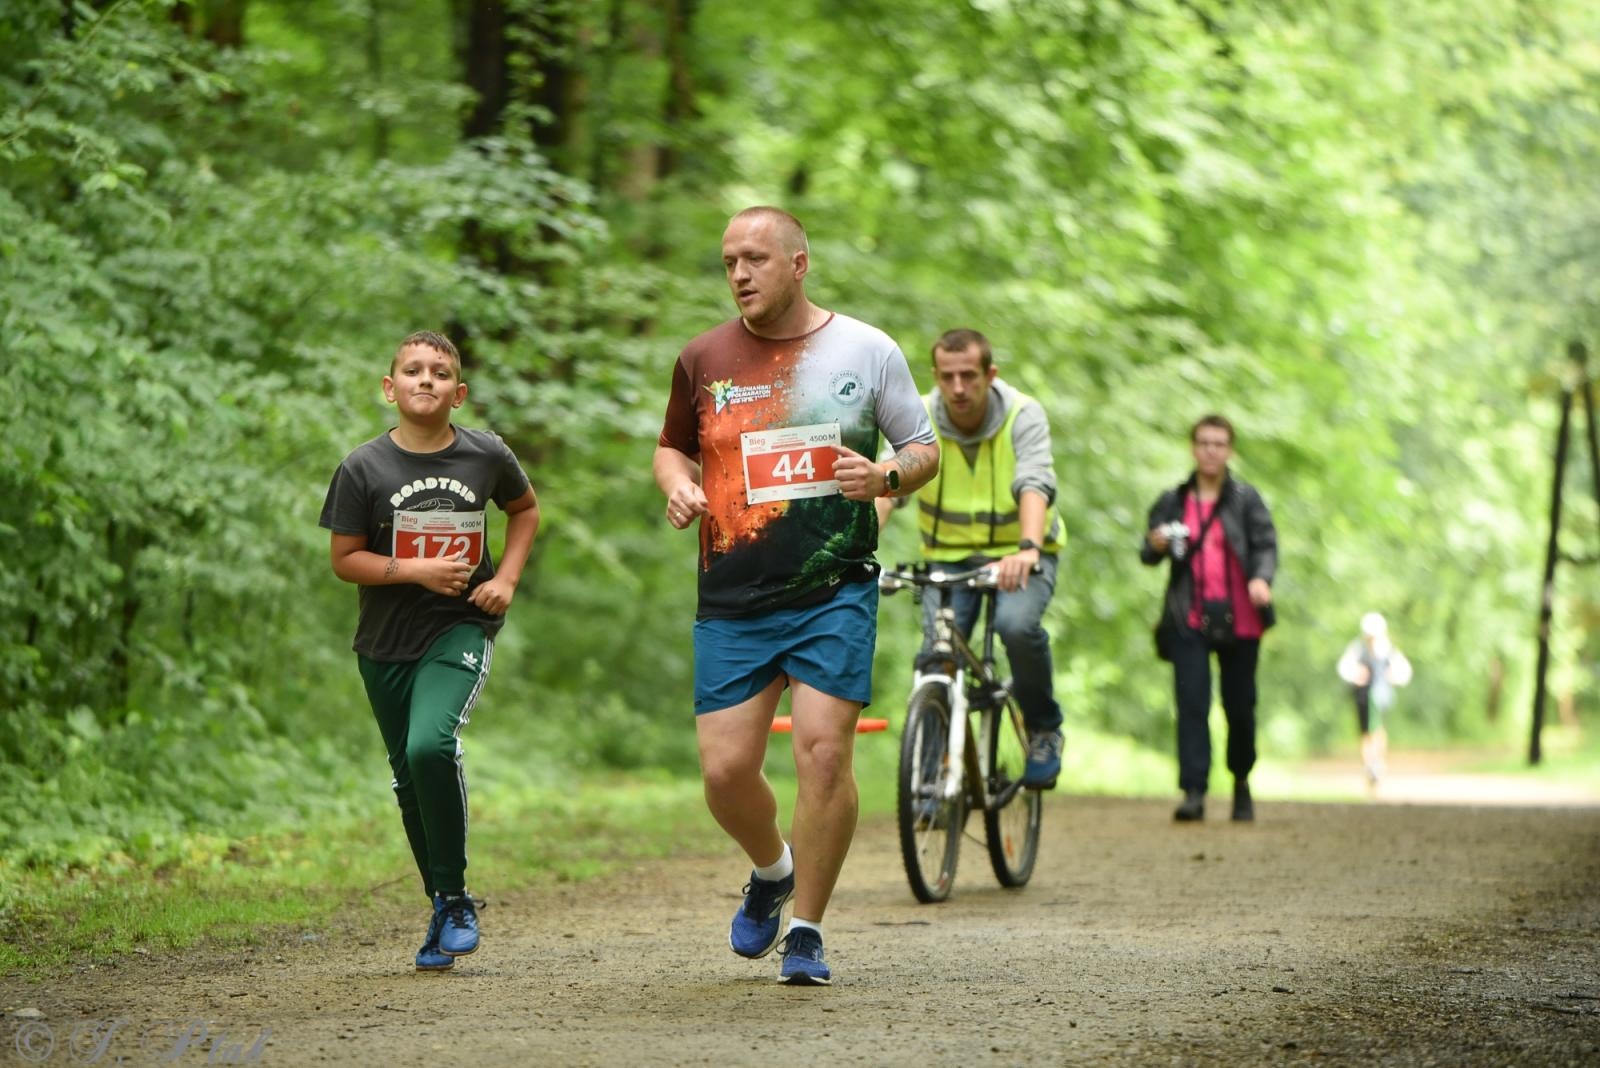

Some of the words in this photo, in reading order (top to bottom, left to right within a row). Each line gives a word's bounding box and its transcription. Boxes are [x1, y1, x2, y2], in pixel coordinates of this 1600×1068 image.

[749, 438, 766, 447] Bieg
[810, 434, 828, 442] 4500
[771, 451, 816, 483] 44
[390, 477, 476, 507] ROADTRIP
[401, 515, 418, 525] Bieg
[411, 535, 471, 564] 172
